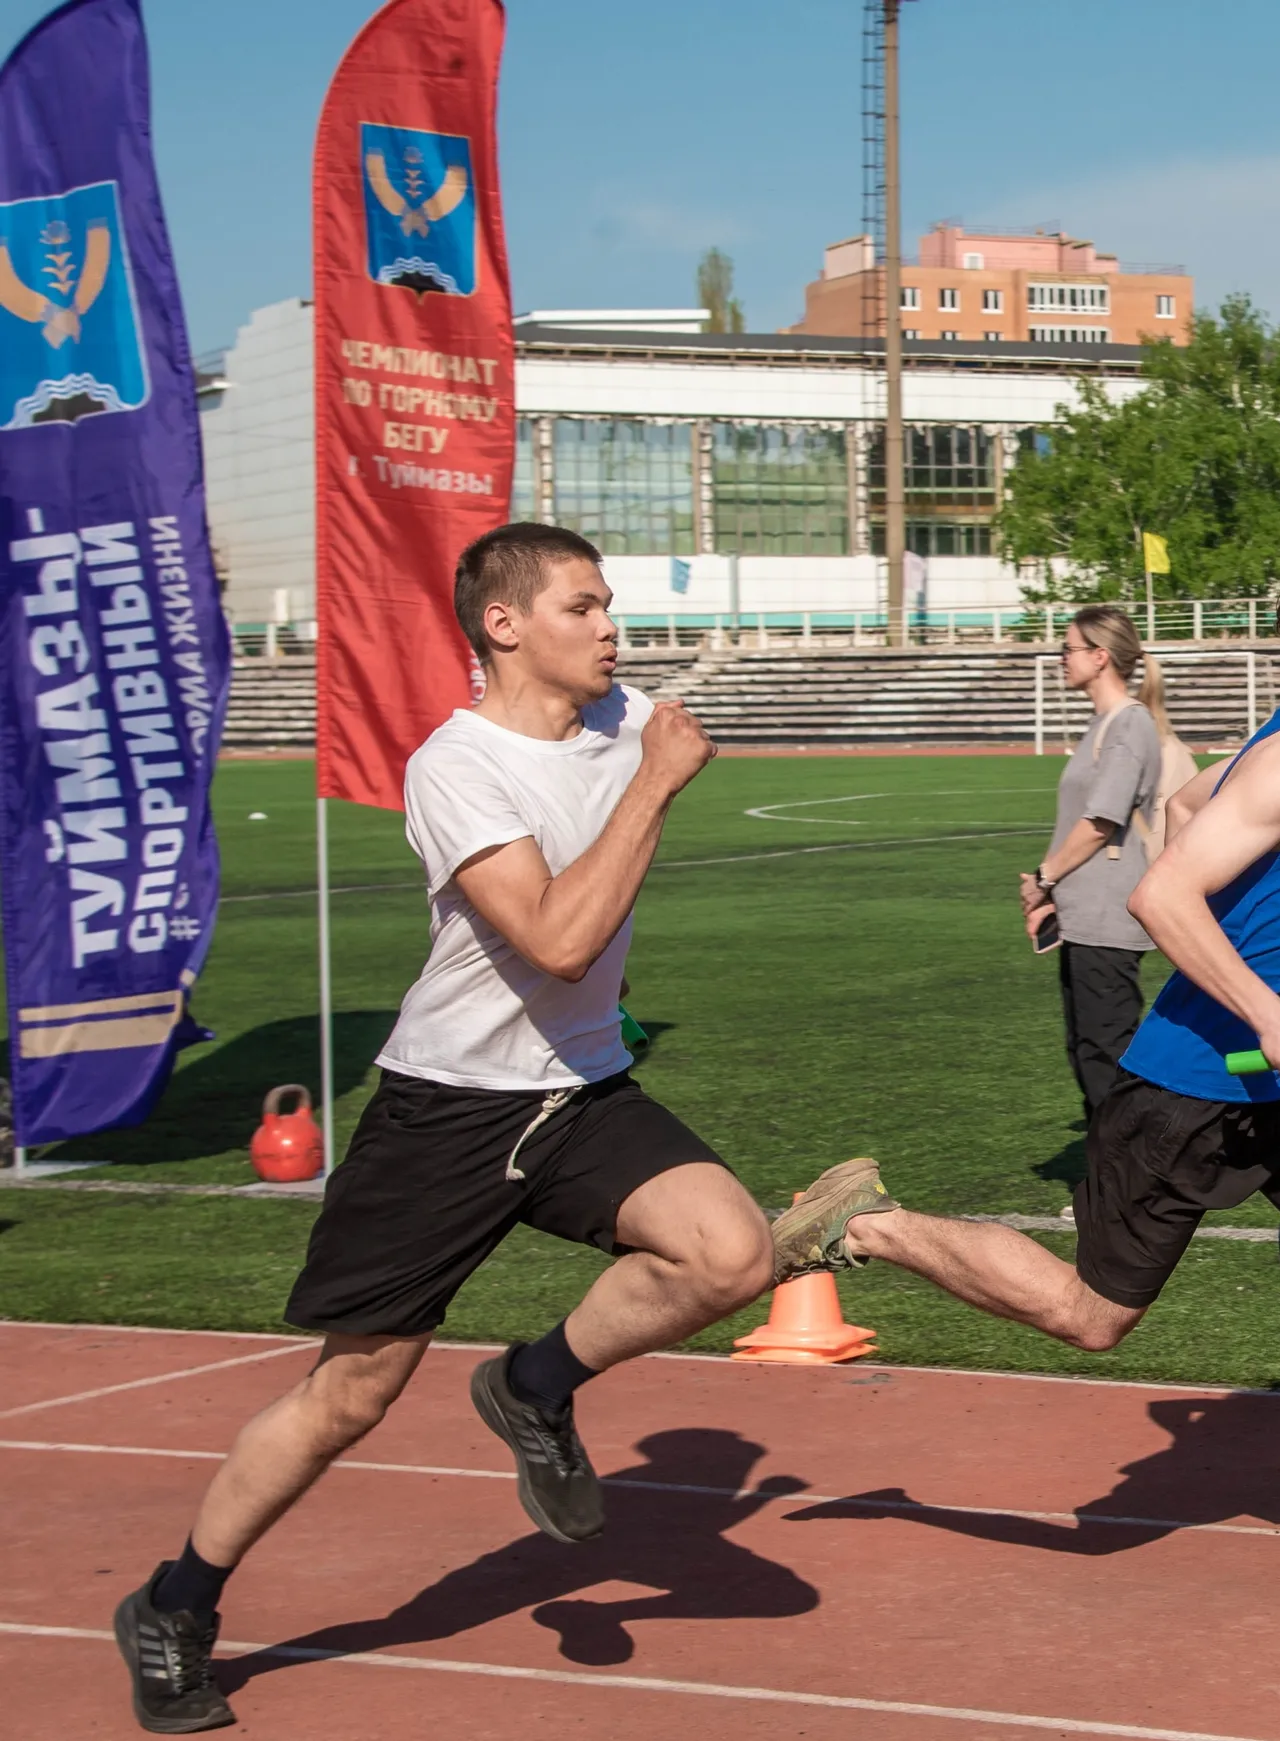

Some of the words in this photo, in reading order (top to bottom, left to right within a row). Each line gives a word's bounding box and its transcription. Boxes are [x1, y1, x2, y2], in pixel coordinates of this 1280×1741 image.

[341, 339, 498, 385] ЧЕМПИОНАТ
[379, 382, 498, 422] ГОРНОМУ
[383, 421, 449, 454] БЕГУ
[372, 455, 493, 494] Туймазы
[74, 522, 188, 953] СПОРТИВНЫЙ
